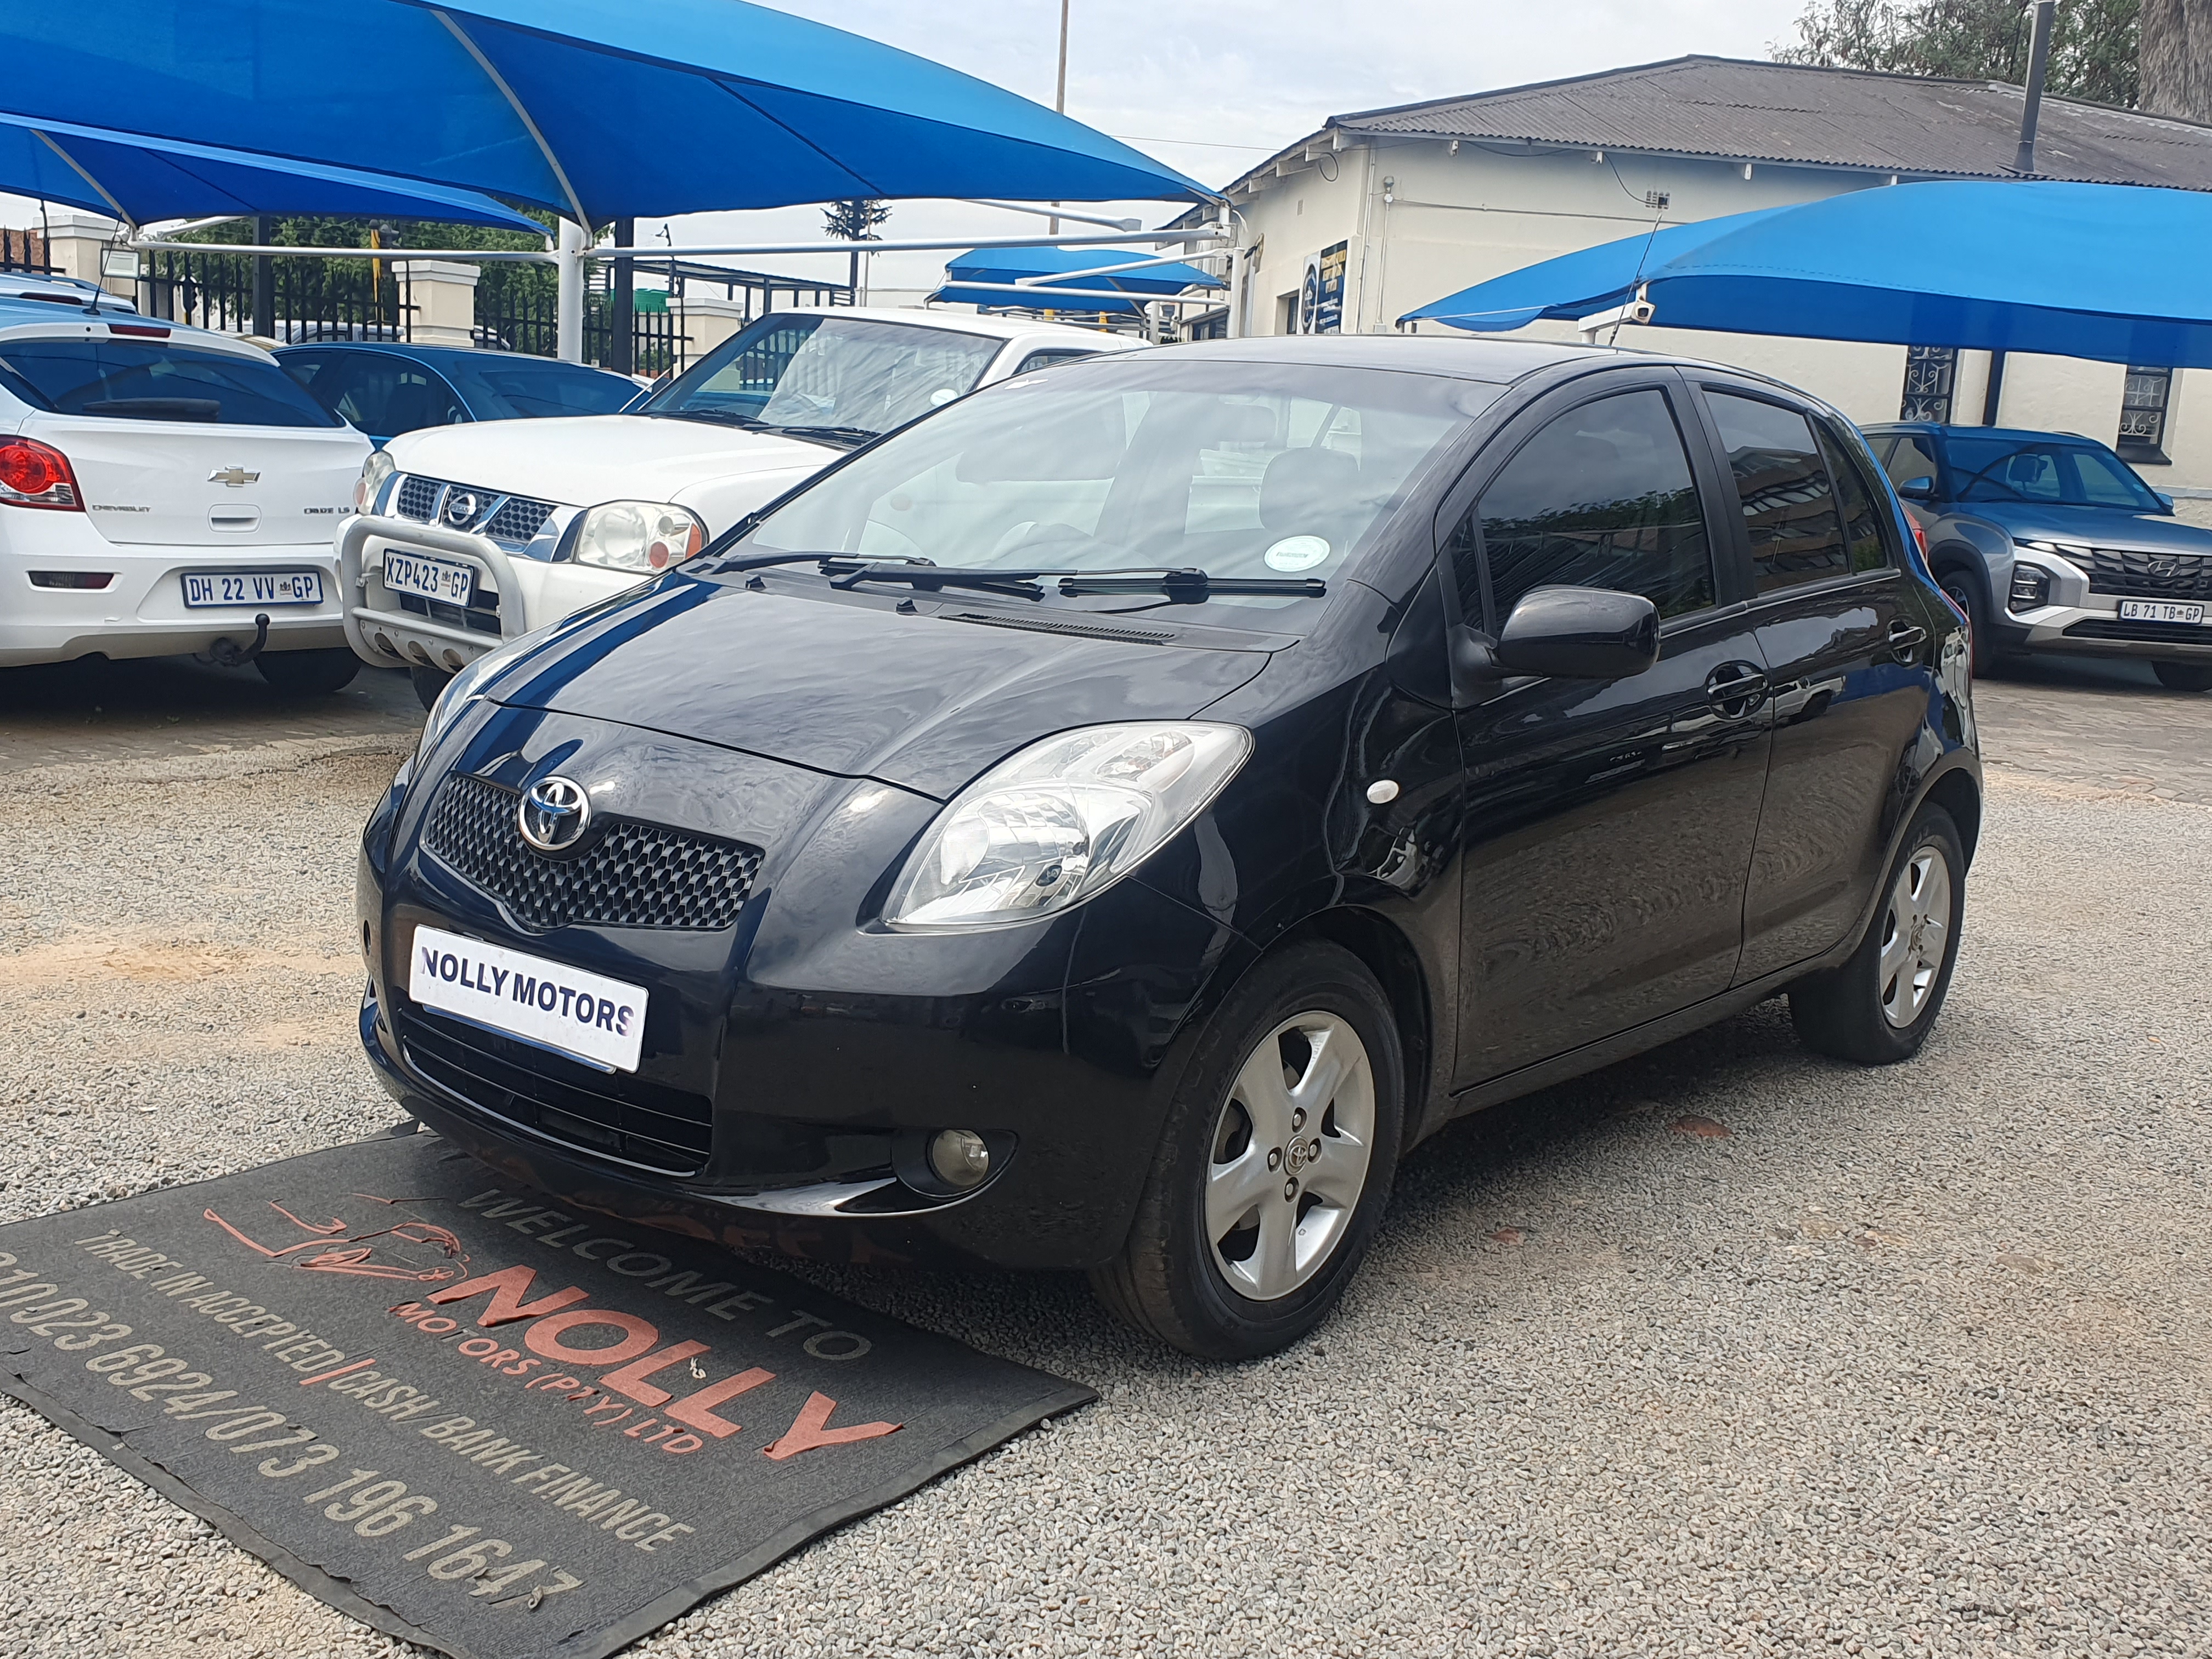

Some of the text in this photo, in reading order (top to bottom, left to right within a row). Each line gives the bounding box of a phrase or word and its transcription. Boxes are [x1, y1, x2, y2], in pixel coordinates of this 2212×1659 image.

[189, 576, 313, 601] DH 22 VV GP
[386, 556, 469, 600] XZP423 GP
[2124, 603, 2199, 620] LB 71 TB GP
[421, 946, 635, 1037] NOLLY MOTORS
[458, 1188, 872, 1361] WELCOME TO
[75, 1229, 184, 1279] TRADE
[150, 1271, 215, 1296] IN
[511, 1463, 697, 1552] FINANCE
[388, 1301, 541, 1375] MOTORS
[624, 1418, 703, 1454] LTD
[427, 1264, 904, 1460] NOLLY
[303, 1468, 438, 1537] 196
[402, 1524, 584, 1609] 1647
